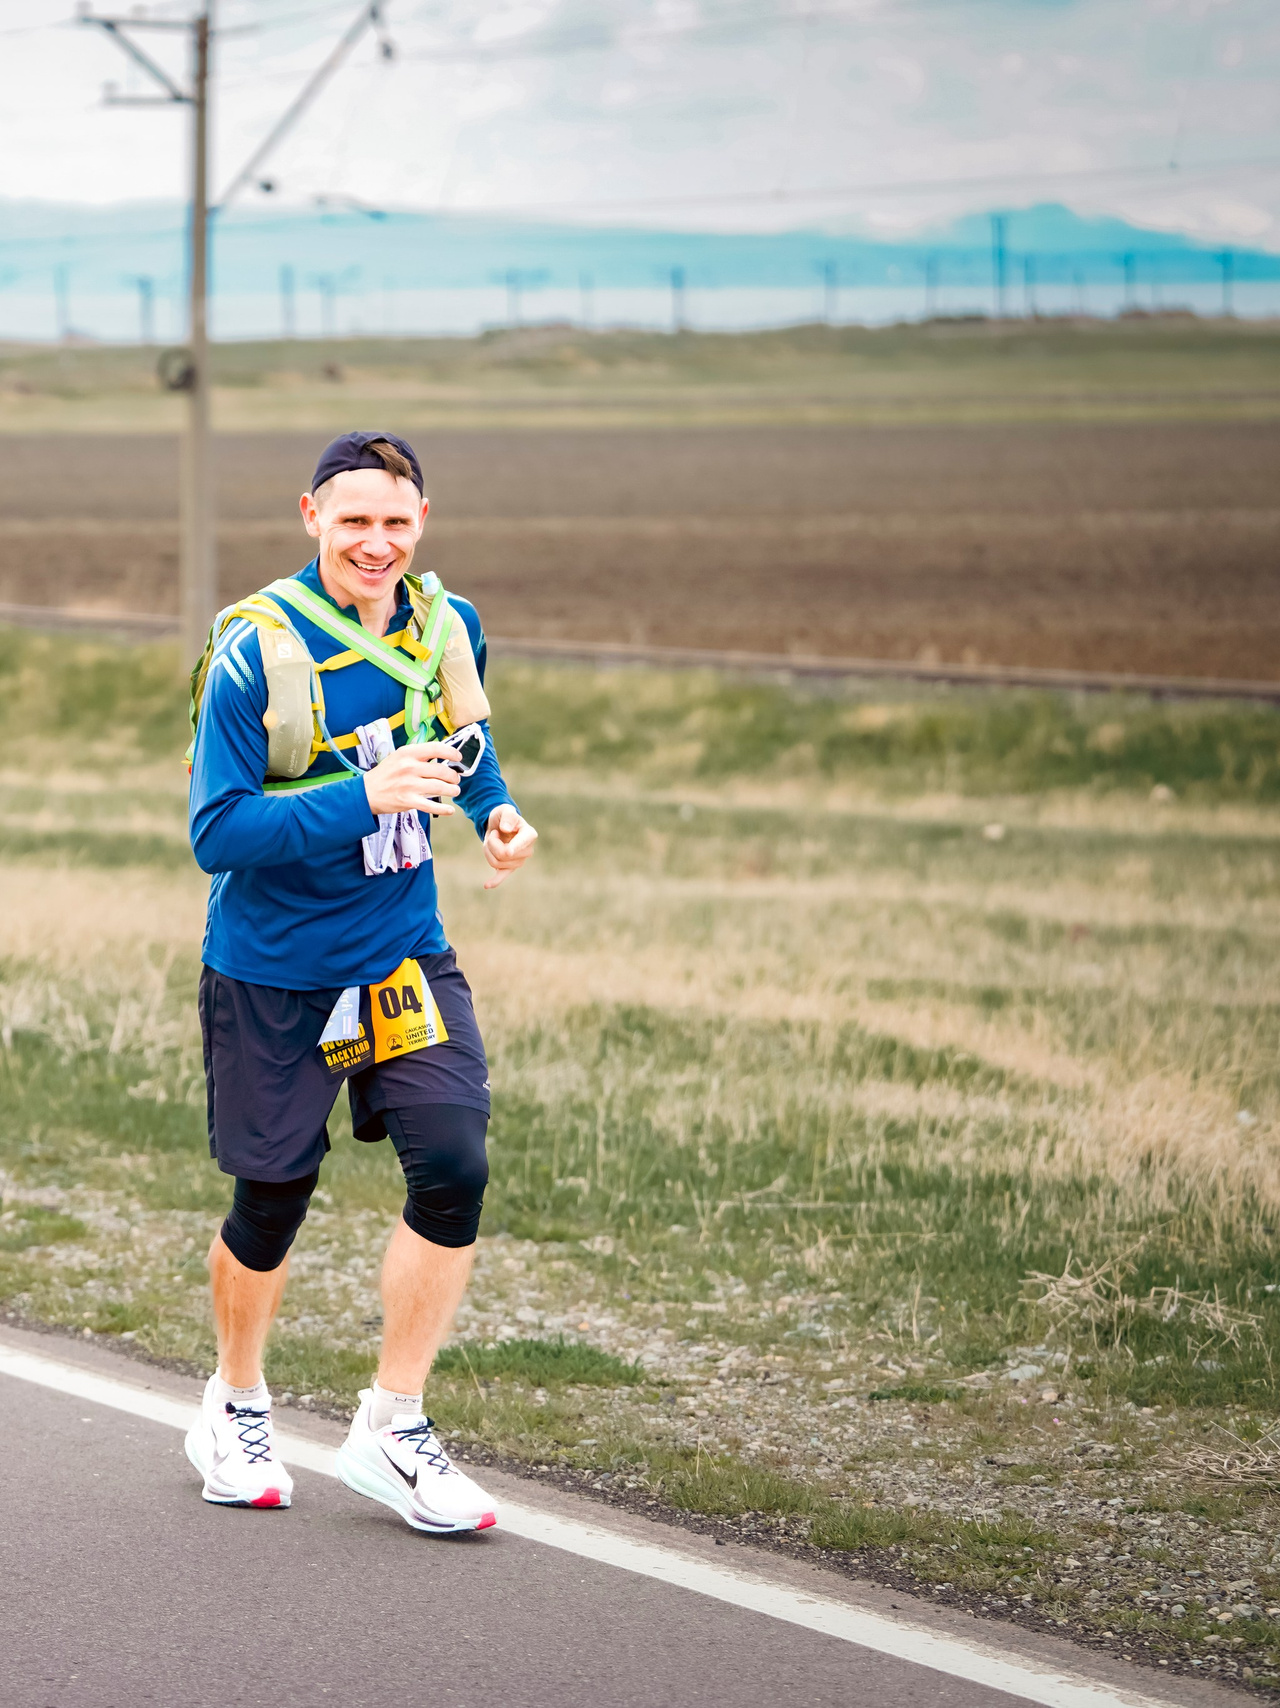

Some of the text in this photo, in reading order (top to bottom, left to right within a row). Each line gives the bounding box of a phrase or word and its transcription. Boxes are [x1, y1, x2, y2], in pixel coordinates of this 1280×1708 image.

[378, 985, 423, 1020] 04
[405, 1022, 432, 1034] CAUCASUS
[406, 1027, 434, 1040] UNITED
[325, 1039, 371, 1067] BACKYARD
[342, 1056, 362, 1068] ULTRA
